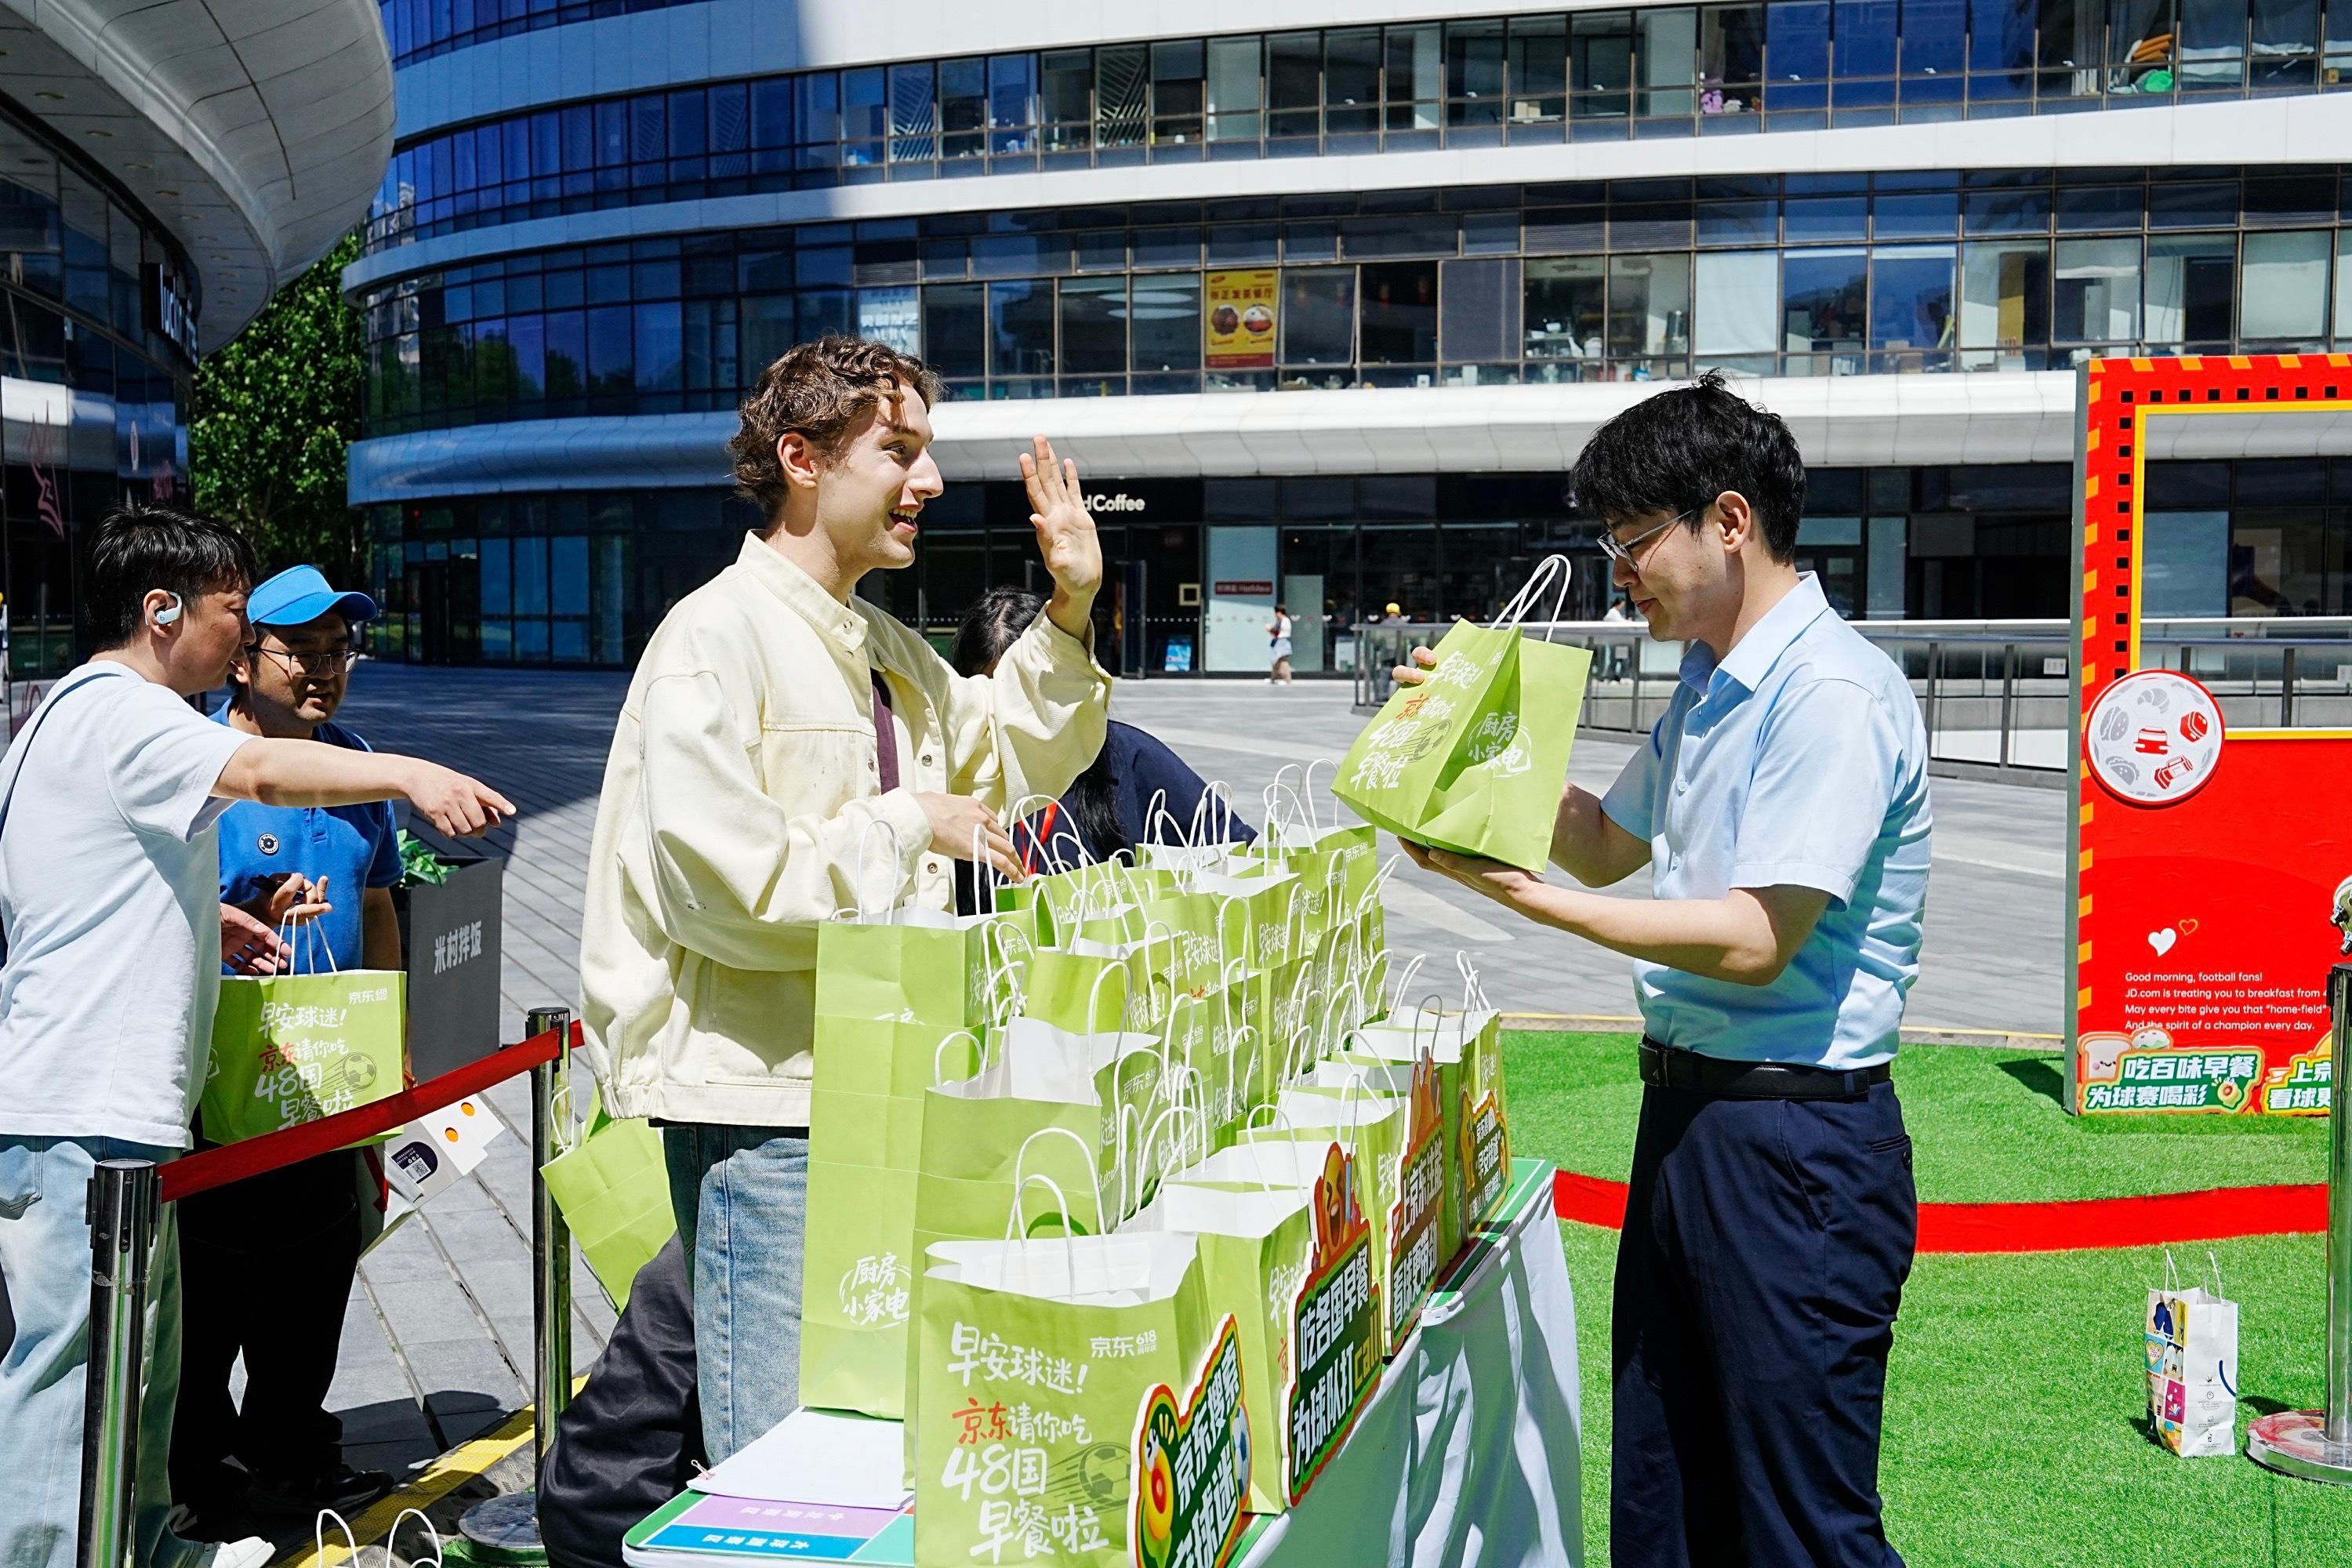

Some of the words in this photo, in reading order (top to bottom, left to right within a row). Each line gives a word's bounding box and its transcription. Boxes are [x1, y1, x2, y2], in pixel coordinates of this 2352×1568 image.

[1477, 711, 1518, 743] 厨房
[1350, 750, 1410, 791] 早餐啦
[1468, 742, 1532, 773] 小家电
[434, 920, 482, 975] 米村拌饭
[348, 990, 376, 1004] 京东
[2125, 972, 2151, 982] Good
[2153, 972, 2196, 984] morning,
[2198, 972, 2236, 982] football
[2238, 972, 2263, 982] fans!
[2125, 989, 2161, 998] JD.com
[2163, 989, 2171, 998] is
[2172, 989, 2212, 1000] treating
[2214, 990, 2233, 1000] you
[2235, 989, 2245, 998] to
[2248, 989, 2294, 998] breakfast
[2297, 989, 2320, 998] from
[258, 1001, 347, 1039] 早安球迷!
[2125, 1004, 2146, 1015] May
[2148, 1006, 2176, 1015] every
[2178, 1004, 2197, 1014] bite
[2199, 1004, 2220, 1015] give
[2222, 1006, 2241, 1016] you
[2243, 1004, 2263, 1014] that
[2125, 1020, 2145, 1029] And
[2165, 1020, 2190, 1031] spirit
[2191, 1020, 2202, 1029] of
[2213, 1020, 2262, 1031] champion
[2264, 1022, 2291, 1031] every
[2293, 1020, 2315, 1032] day.
[258, 1038, 350, 1073] 京东请你吃
[2124, 1055, 2256, 1080] 吃百味早餐
[254, 1062, 322, 1102] 48国
[1123, 1073, 1145, 1102] 京东
[2085, 1083, 2207, 1109] 为球赛喝彩
[851, 1252, 897, 1292] 厨房
[1393, 1215, 1438, 1331] 看球更带劲
[843, 1287, 909, 1325] 小家电
[1300, 1245, 1369, 1374] 吃各国早餐
[947, 1320, 1088, 1393] 早安球迷!
[1090, 1336, 1135, 1358] 京东
[1136, 1330, 1157, 1345] 618
[1293, 1305, 1381, 1478] 为球队打call
[952, 1397, 1092, 1445] 京东请你吃
[1174, 1338, 1240, 1516] 京东搜索
[941, 1444, 1047, 1502] 48国
[969, 1497, 1109, 1565] 早餐啦
